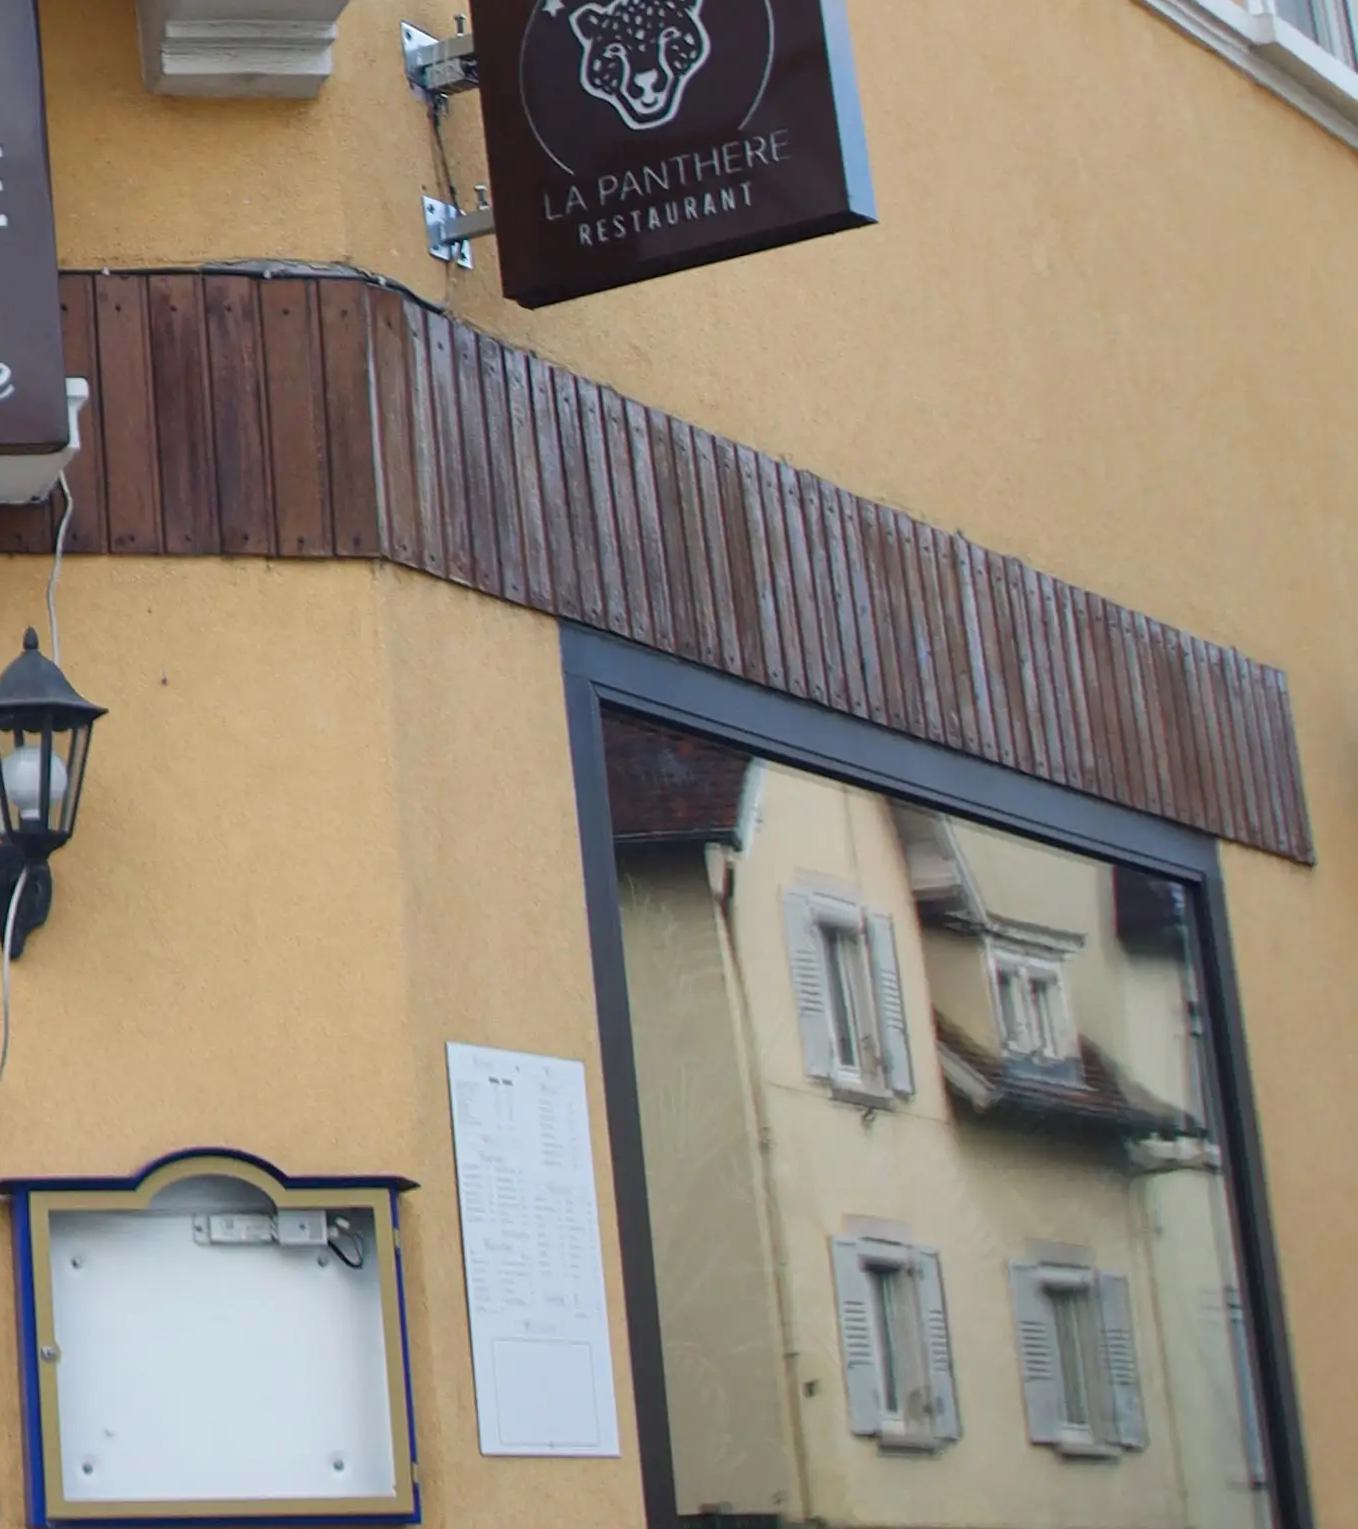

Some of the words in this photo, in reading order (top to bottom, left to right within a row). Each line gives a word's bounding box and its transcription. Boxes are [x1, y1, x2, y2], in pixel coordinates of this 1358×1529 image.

[543, 185, 588, 221] LA
[598, 129, 792, 206] PANTHERE
[579, 182, 752, 246] RESTAURANT
